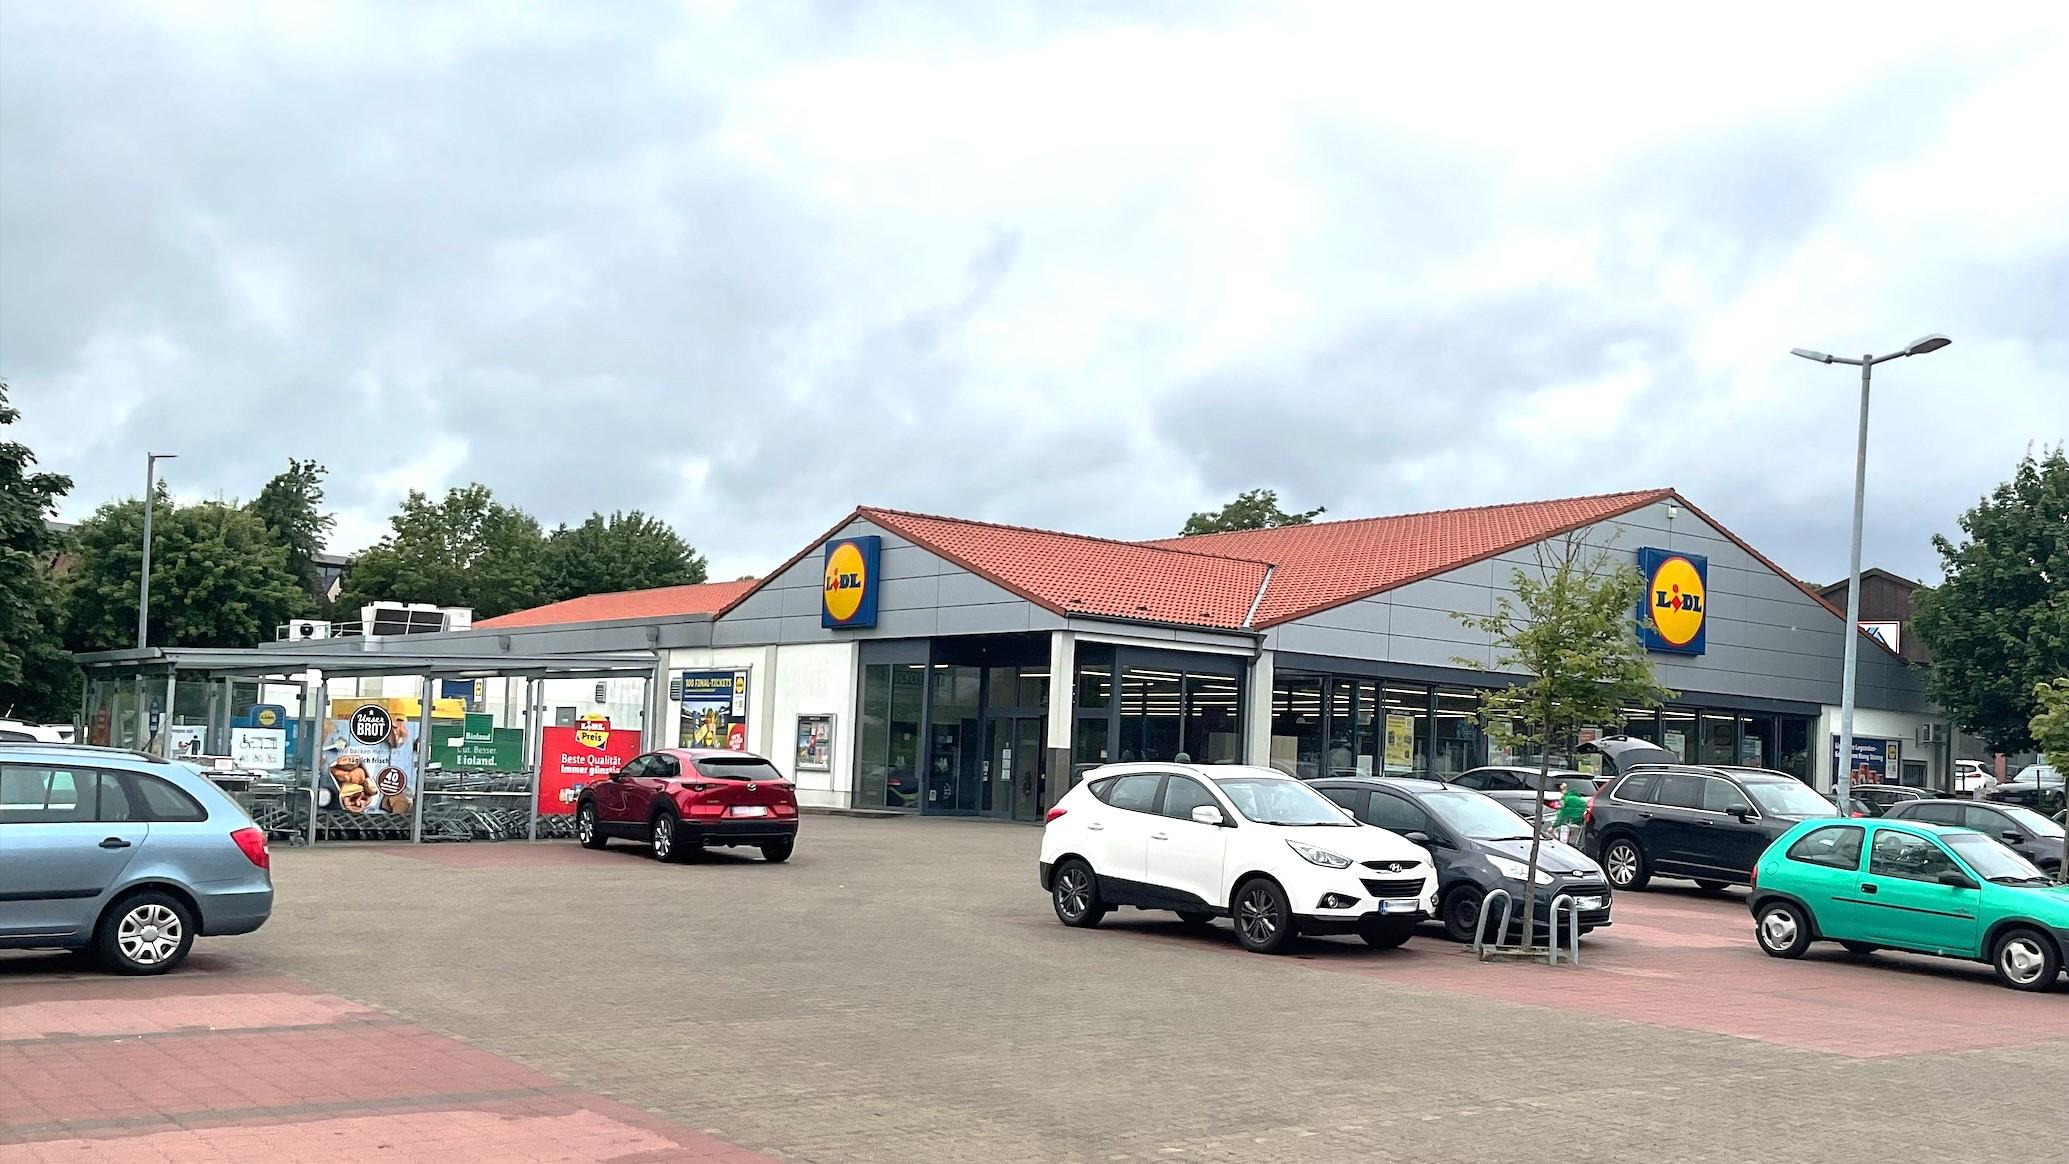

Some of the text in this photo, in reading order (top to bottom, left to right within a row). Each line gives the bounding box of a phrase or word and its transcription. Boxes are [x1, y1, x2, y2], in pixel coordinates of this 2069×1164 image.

[357, 713, 386, 723] Unser
[356, 723, 386, 737] BROT
[465, 732, 491, 741] Bioland
[581, 732, 602, 742] Preis
[457, 755, 497, 766] Bioland.
[561, 753, 622, 766] Beste Qualität
[561, 765, 588, 774] Immer
[386, 772, 399, 782] 40
